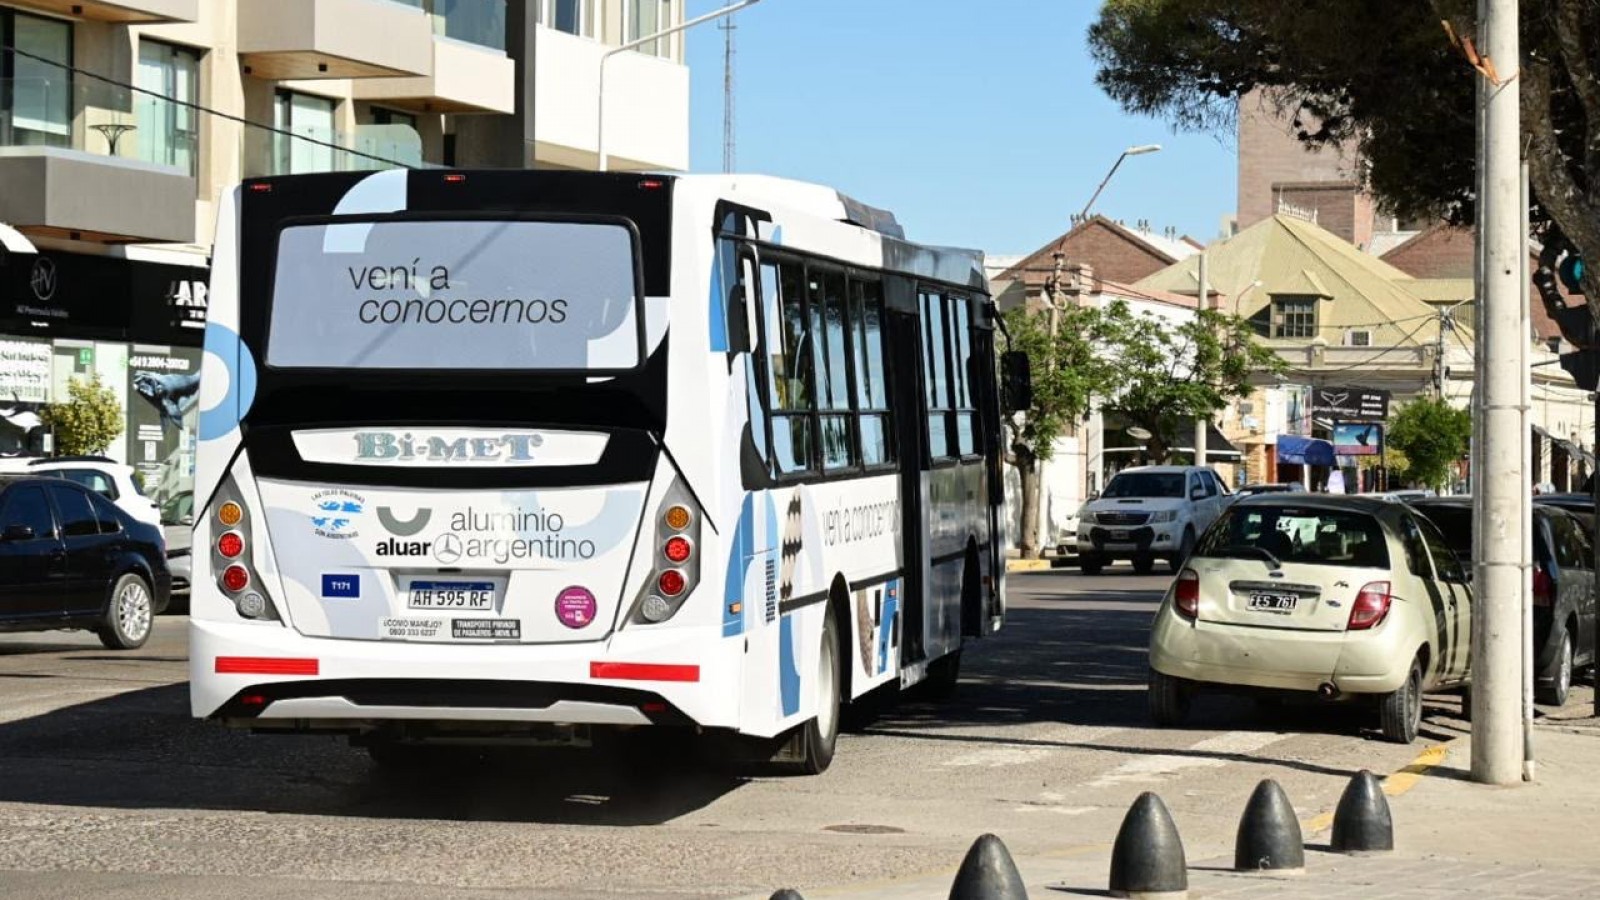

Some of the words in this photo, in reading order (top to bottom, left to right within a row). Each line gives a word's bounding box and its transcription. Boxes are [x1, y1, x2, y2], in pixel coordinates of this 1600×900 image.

[348, 257, 420, 291] vení
[430, 265, 451, 291] a
[173, 280, 209, 307] AR
[358, 298, 569, 325] conocernos
[353, 432, 544, 462] Bi-MET
[450, 506, 564, 533] aluminio
[376, 538, 432, 557] aluar
[466, 533, 596, 565] argentino
[331, 581, 351, 591] T171
[413, 590, 432, 606] AH
[436, 590, 465, 607] 595
[469, 591, 490, 607] RF
